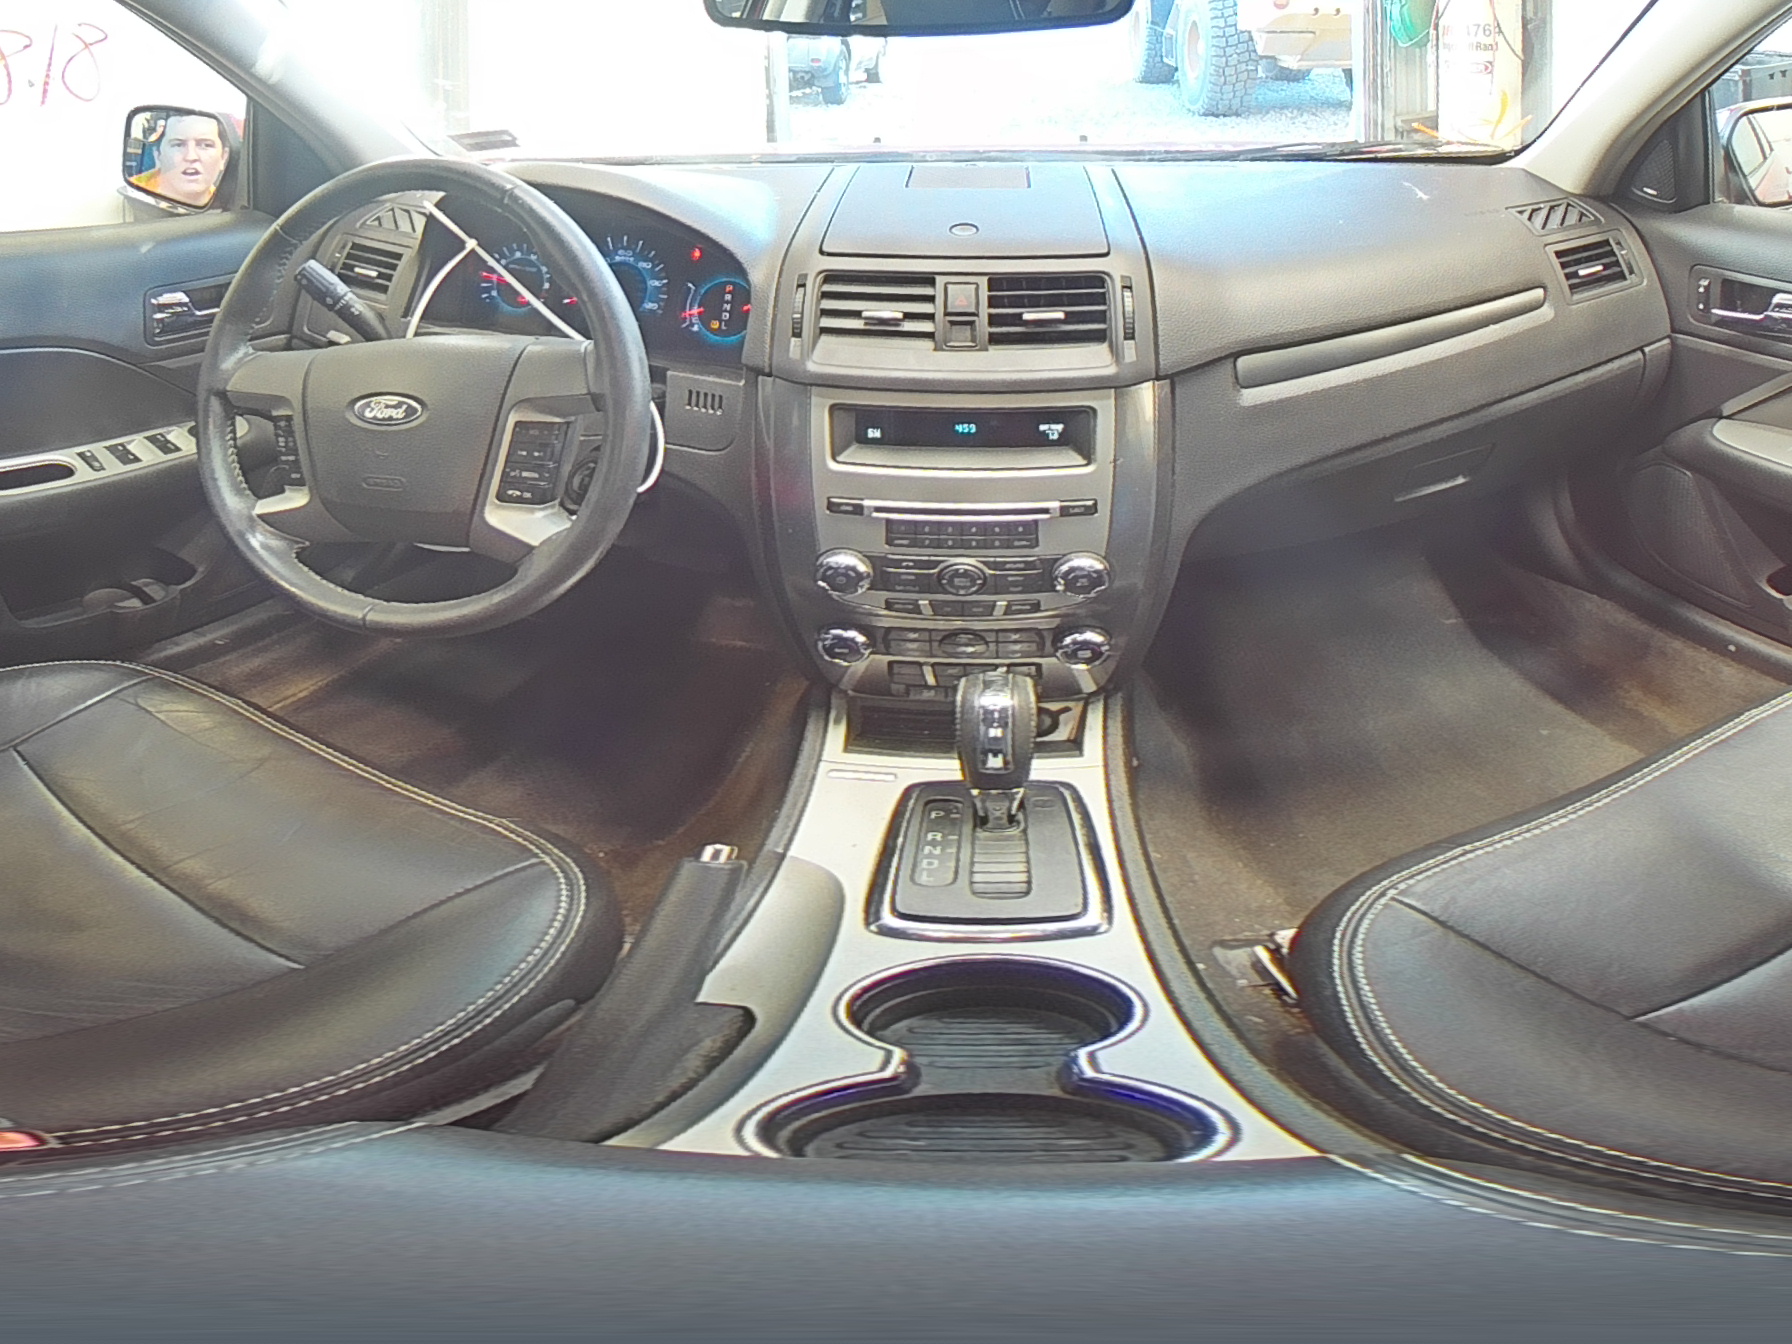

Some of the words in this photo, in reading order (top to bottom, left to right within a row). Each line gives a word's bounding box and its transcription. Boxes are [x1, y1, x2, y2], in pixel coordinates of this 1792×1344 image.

[364, 399, 408, 419] Ford
[930, 810, 946, 820] P
[926, 831, 943, 842] R
[923, 845, 943, 855] N
[921, 858, 940, 870] D
[921, 870, 935, 882] L
